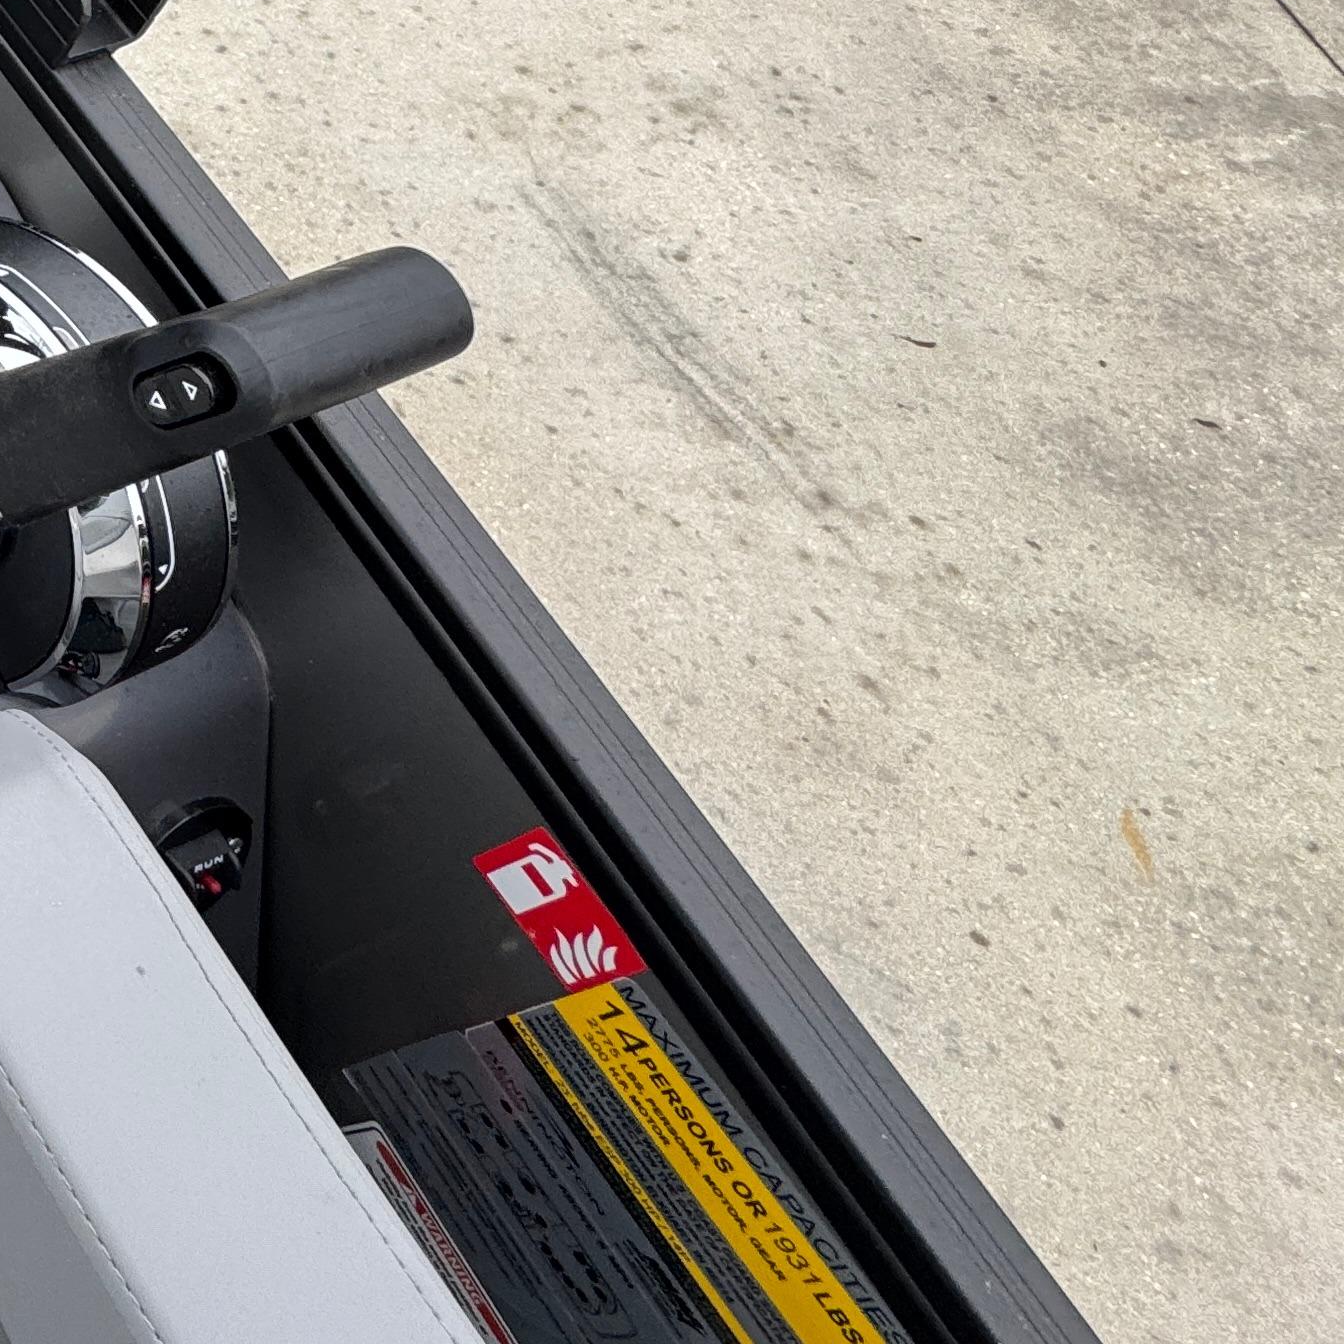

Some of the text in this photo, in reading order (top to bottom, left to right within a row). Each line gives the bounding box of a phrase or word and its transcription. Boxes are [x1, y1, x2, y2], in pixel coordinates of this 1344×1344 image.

[194, 854, 224, 873] RUN
[582, 1032, 609, 1062] 300
[627, 1094, 671, 1146] MOTOR
[617, 985, 744, 1137] MAXIMUM
[585, 1018, 621, 1058] 2775
[748, 1236, 787, 1281] GEAR
[590, 998, 653, 1057] 14
[636, 1056, 735, 1174] PERSONS
[728, 1178, 768, 1218] OR
[762, 1222, 822, 1287] 1931
[811, 1289, 865, 1344] LBS
[418, 1211, 485, 1305] WARNING
